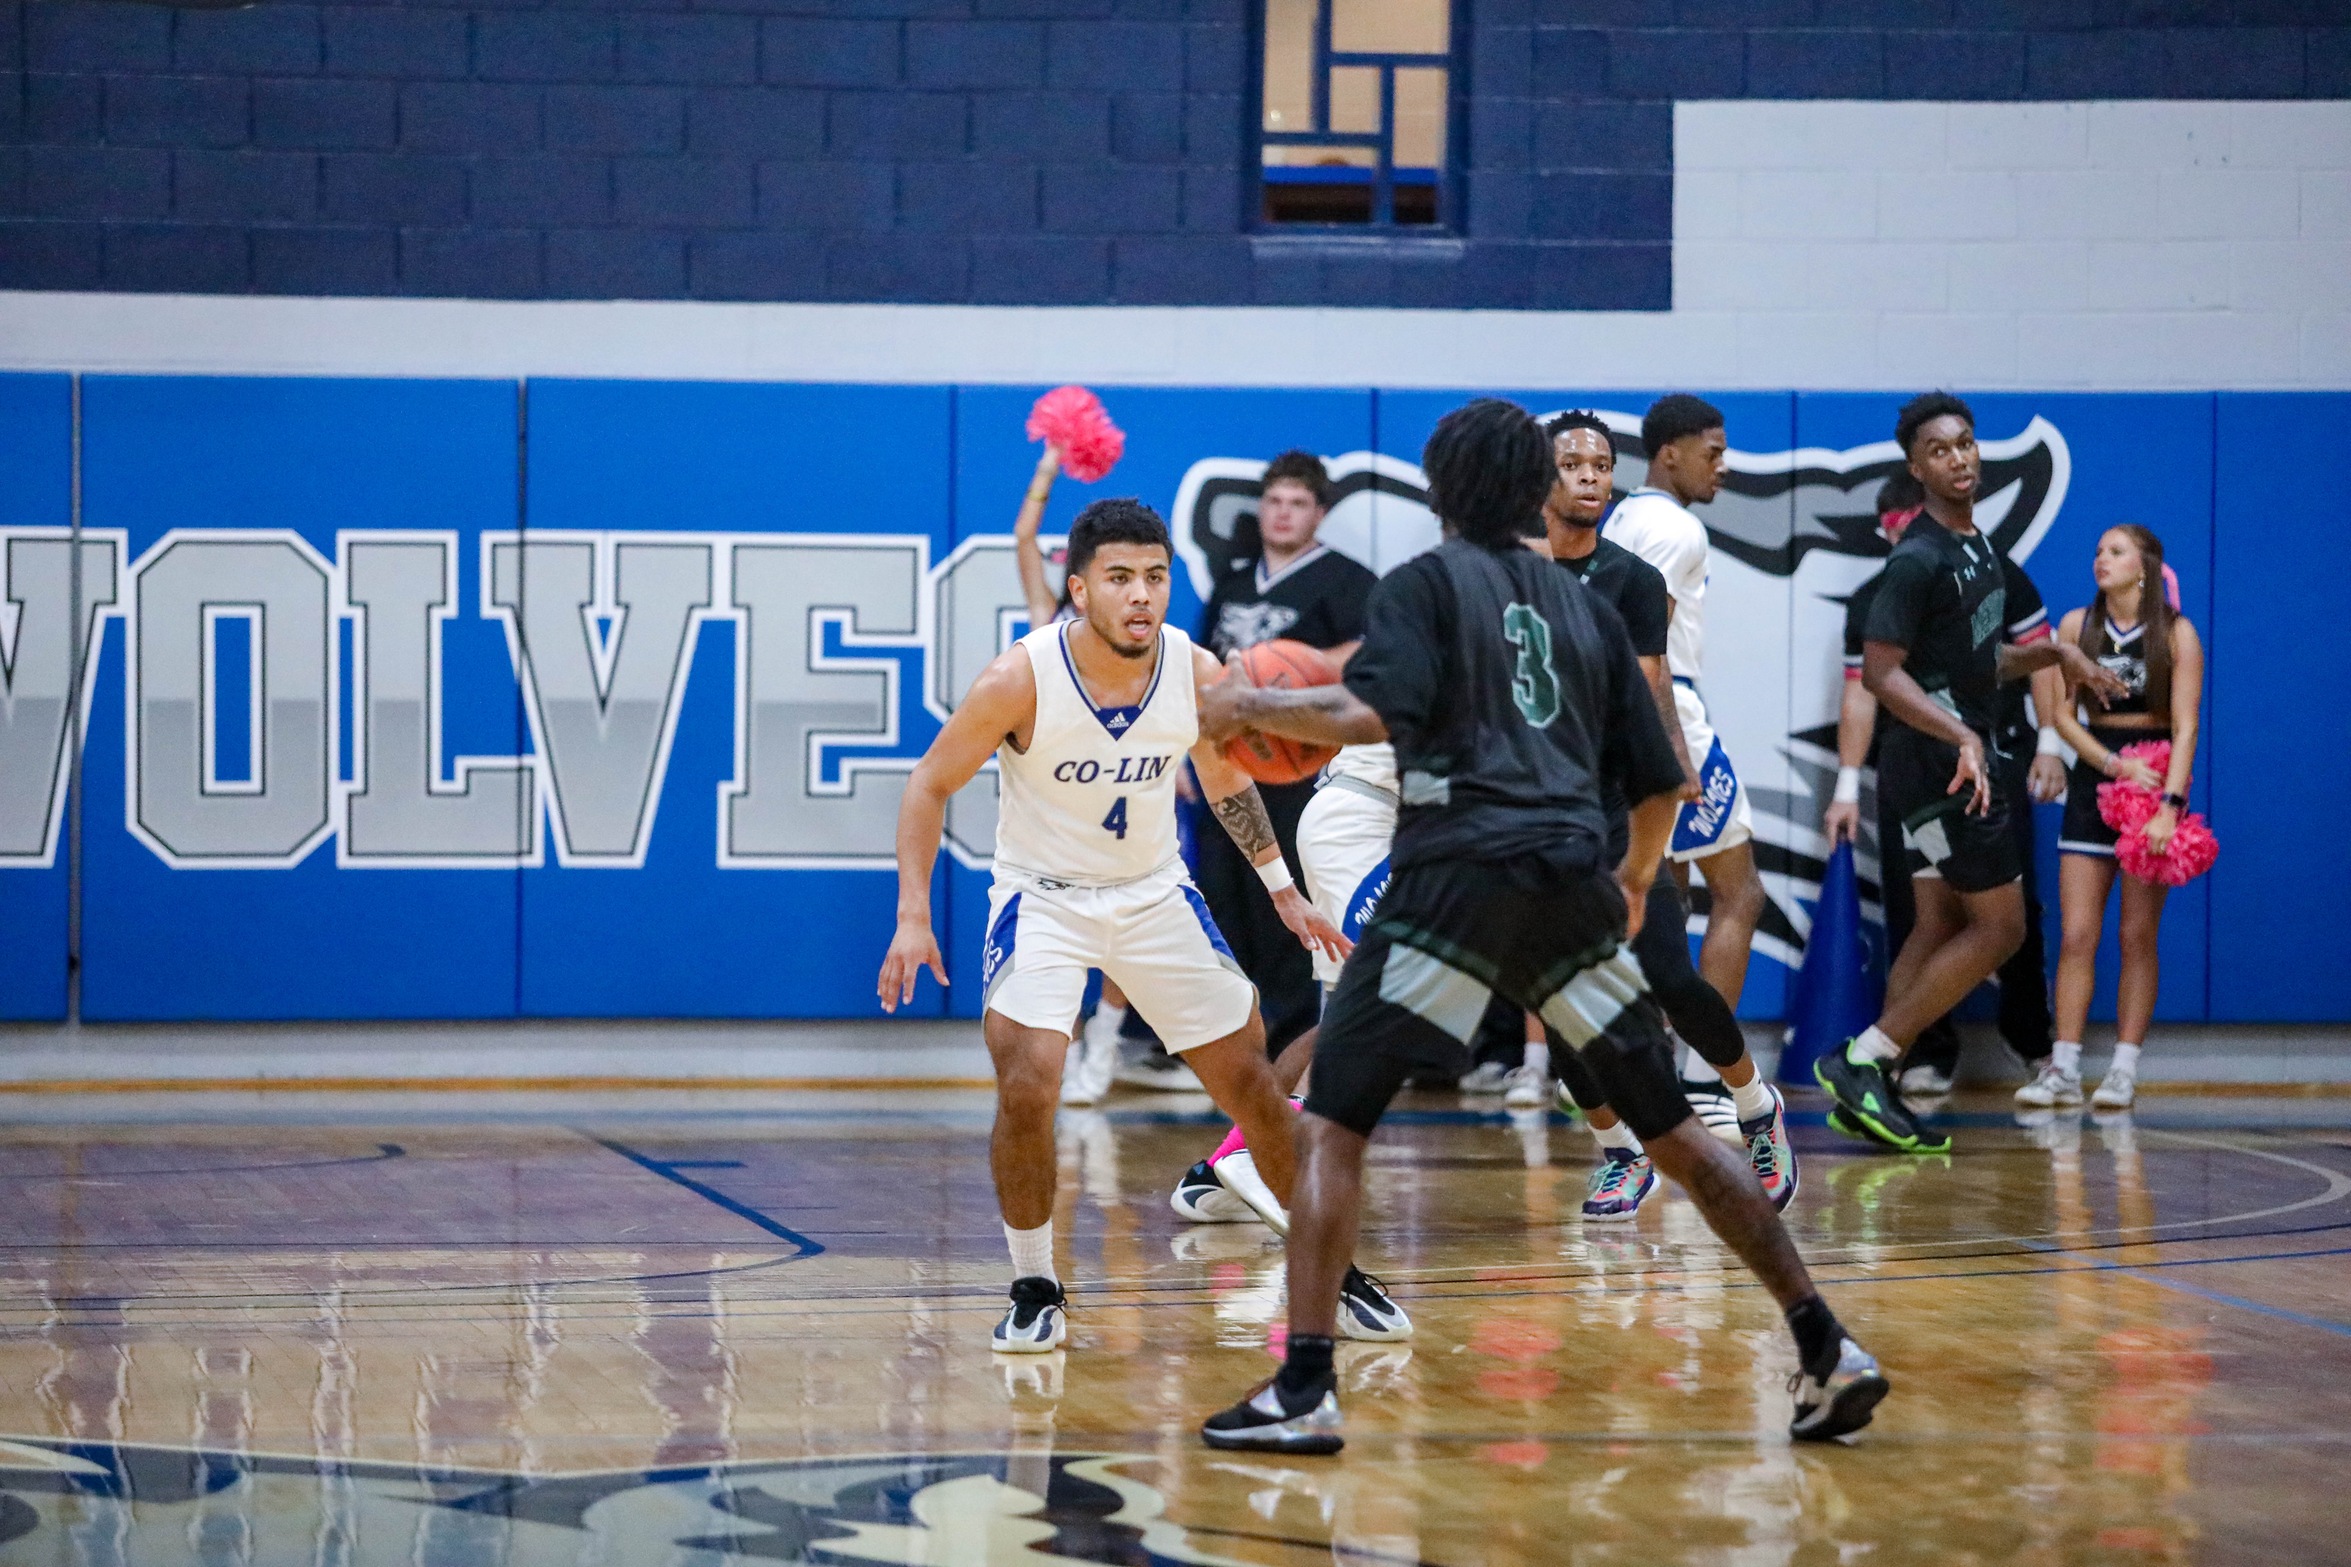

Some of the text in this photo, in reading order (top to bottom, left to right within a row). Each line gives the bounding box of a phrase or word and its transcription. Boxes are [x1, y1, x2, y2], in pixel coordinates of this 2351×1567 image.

[1503, 601, 1560, 729] 3
[1053, 754, 1173, 784] CO-LIN
[1101, 796, 1128, 840] 4
[1688, 766, 1735, 838] WOLVES
